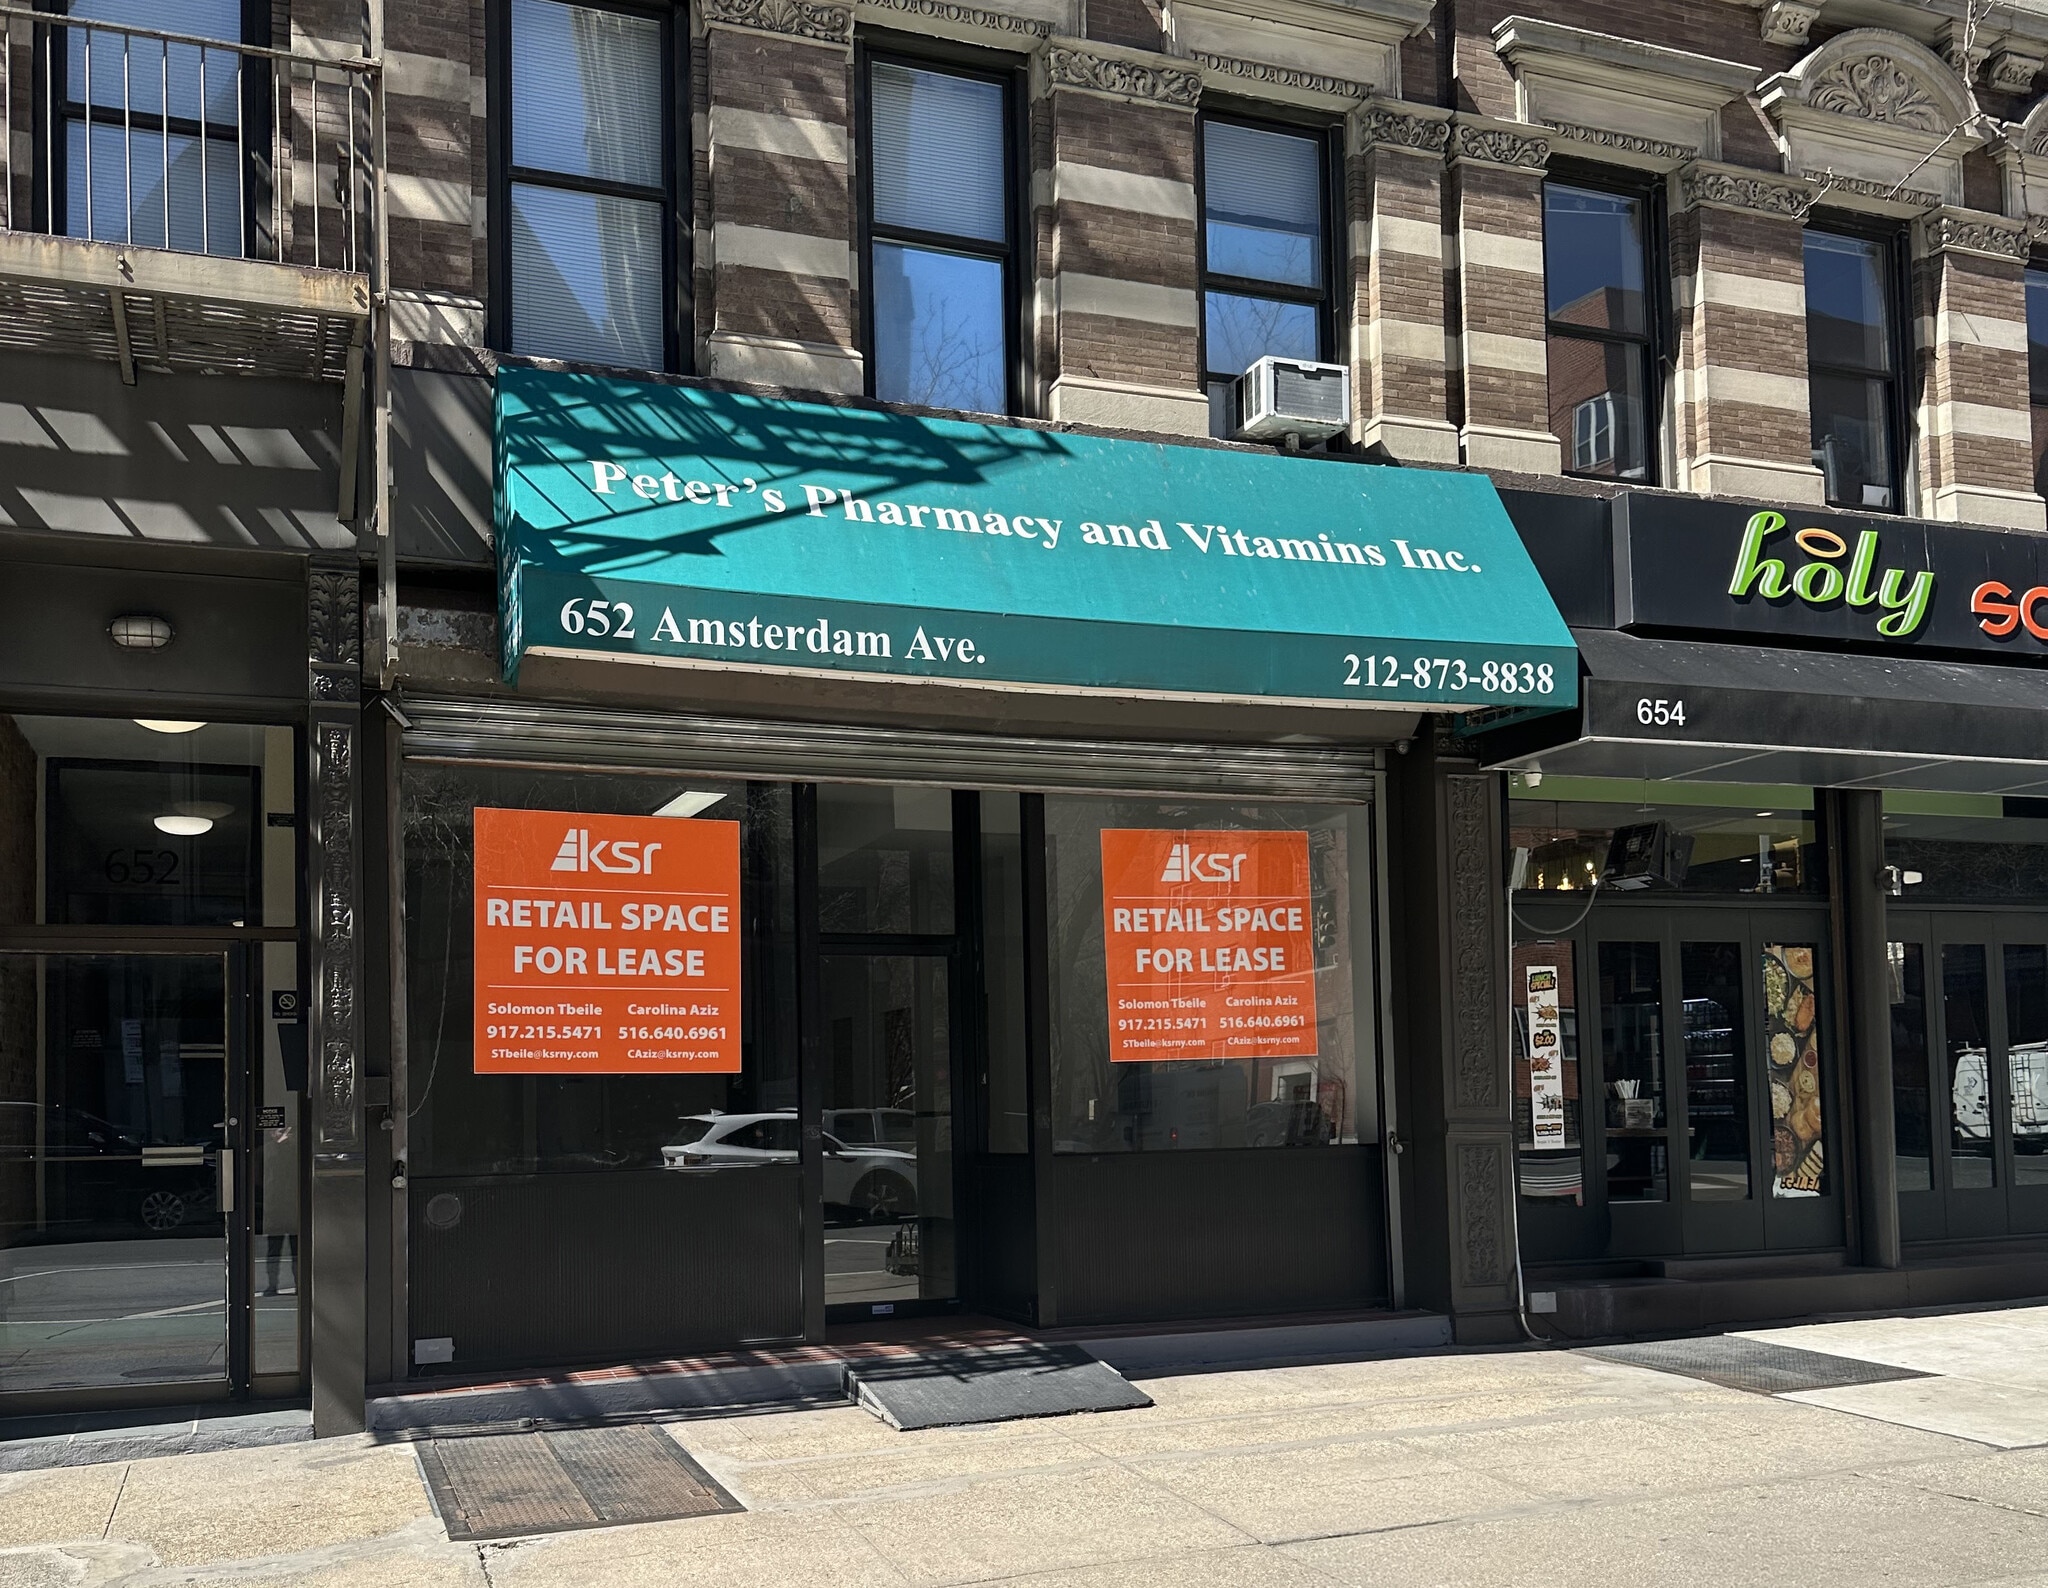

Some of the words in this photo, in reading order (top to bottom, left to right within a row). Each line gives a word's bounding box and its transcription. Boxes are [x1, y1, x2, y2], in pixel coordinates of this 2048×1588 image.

[587, 459, 786, 514] Peter’s
[799, 484, 1063, 549] Pharmacy
[1080, 519, 1171, 551] and
[1177, 522, 1386, 567] Vitamins
[1390, 539, 1482, 573] Inc.
[1728, 511, 1935, 637] holy
[560, 597, 636, 639] 652
[650, 606, 892, 659] Amsterdam
[905, 625, 986, 664] Ave.
[1343, 653, 1554, 694] 212-873-8838
[1637, 698, 1686, 726] 654
[579, 829, 662, 875] ksr
[105, 848, 180, 885] 652
[1182, 844, 1247, 882] ksr
[487, 898, 612, 930] RETAIL
[621, 903, 729, 933] SPACE
[1113, 908, 1211, 932] RETAIL
[1217, 907, 1303, 932] SPACE
[514, 945, 588, 975] FOR
[597, 947, 705, 977] LEASE
[1136, 948, 1193, 973] FOR
[1200, 947, 1286, 972] LEASE
[487, 1002, 555, 1016] Solomon
[557, 1003, 603, 1017] Tbeile
[627, 1003, 687, 1017] Carolina
[690, 1004, 720, 1017] Aziz
[1118, 998, 1169, 1010] Solomon
[1171, 998, 1207, 1009] Tbeile
[1225, 995, 1272, 1007] Carolina
[1275, 995, 1299, 1006] Aziz
[1118, 1017, 1207, 1031] 917.215.5471
[1219, 1015, 1305, 1029] 516.640.6961
[486, 1025, 602, 1040] 917.215.5471
[618, 1026, 727, 1041] 516.640.6961
[1227, 1035, 1300, 1047] CAziz@ksrny.com
[1122, 1037, 1206, 1050] STbeile@ksrny.com
[491, 1048, 599, 1061] STbeile@ksrny.com
[627, 1048, 720, 1061] CAziz@ksrny.com
